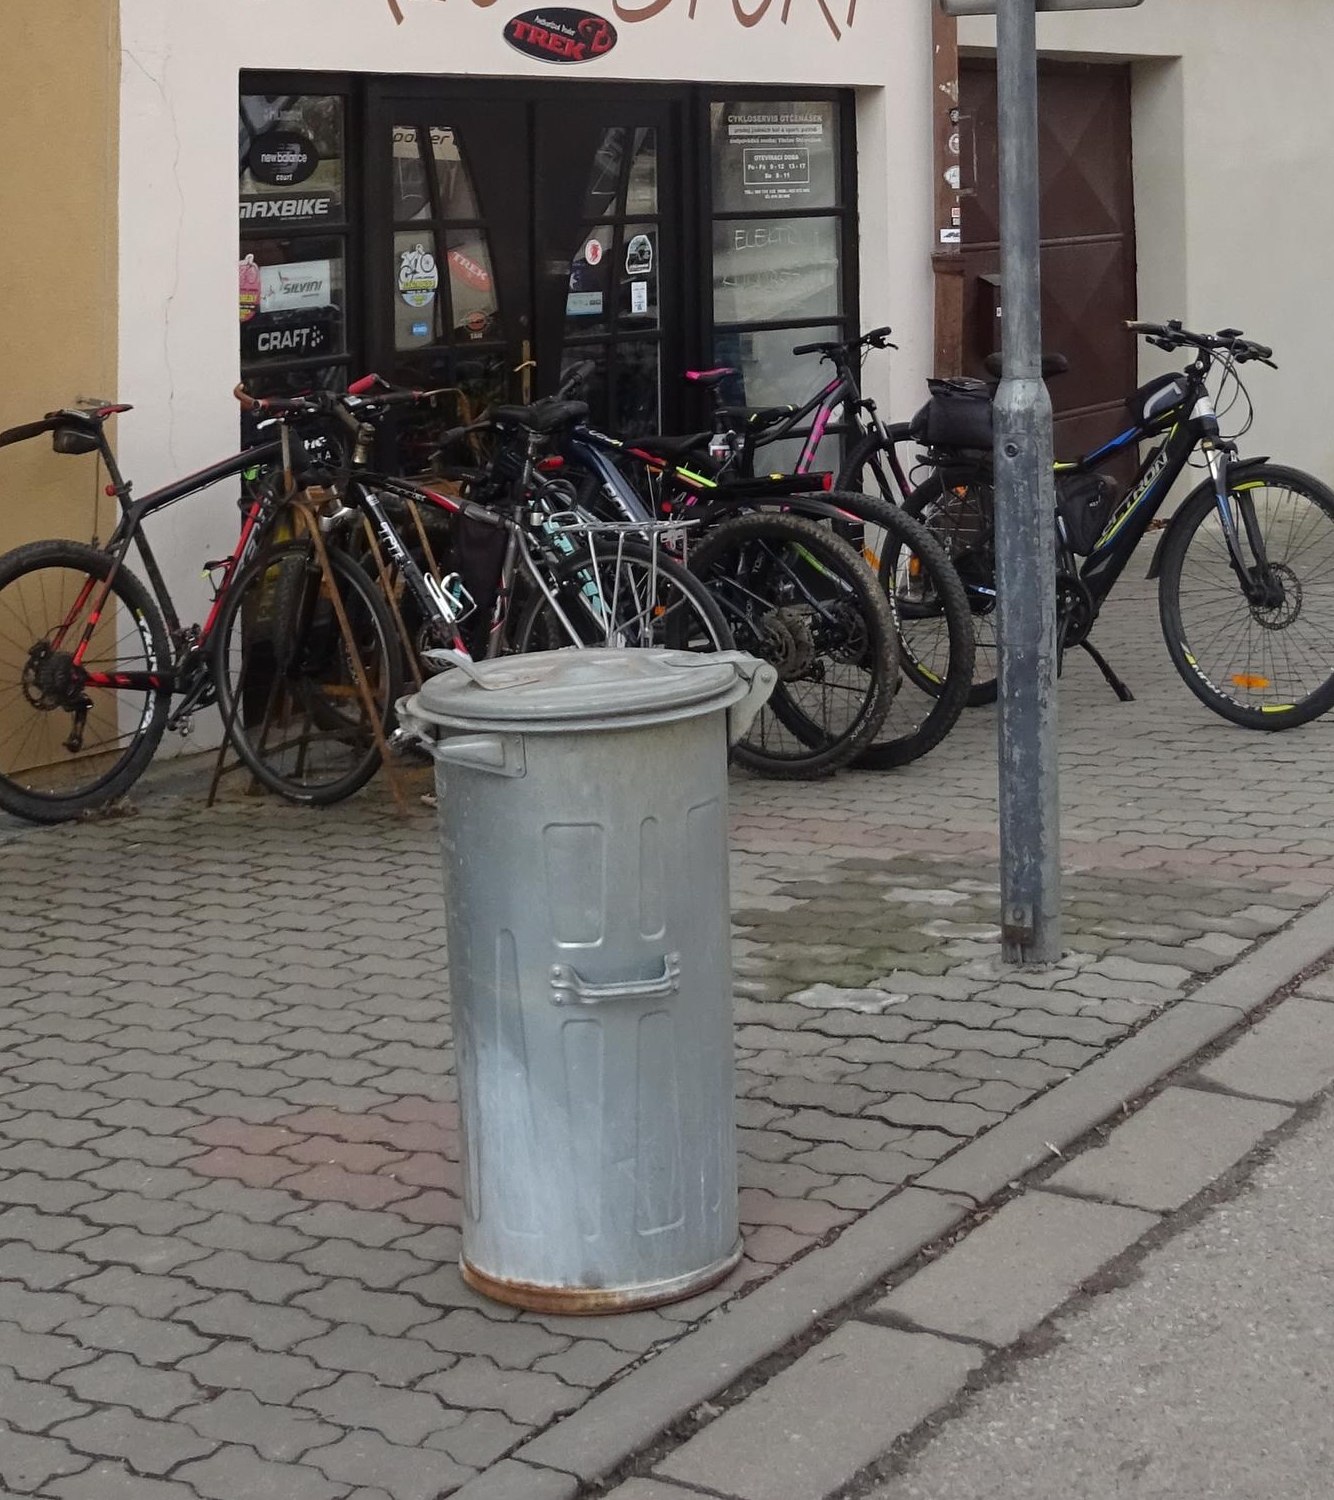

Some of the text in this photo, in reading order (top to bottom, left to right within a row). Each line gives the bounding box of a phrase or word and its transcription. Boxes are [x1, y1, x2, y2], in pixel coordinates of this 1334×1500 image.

[511, 18, 586, 61] TREK
[728, 115, 778, 123] CYKLOSERVIS
[239, 198, 330, 219] MAXBIKE
[283, 281, 322, 295] SILVINI
[257, 328, 311, 352] CRAFT
